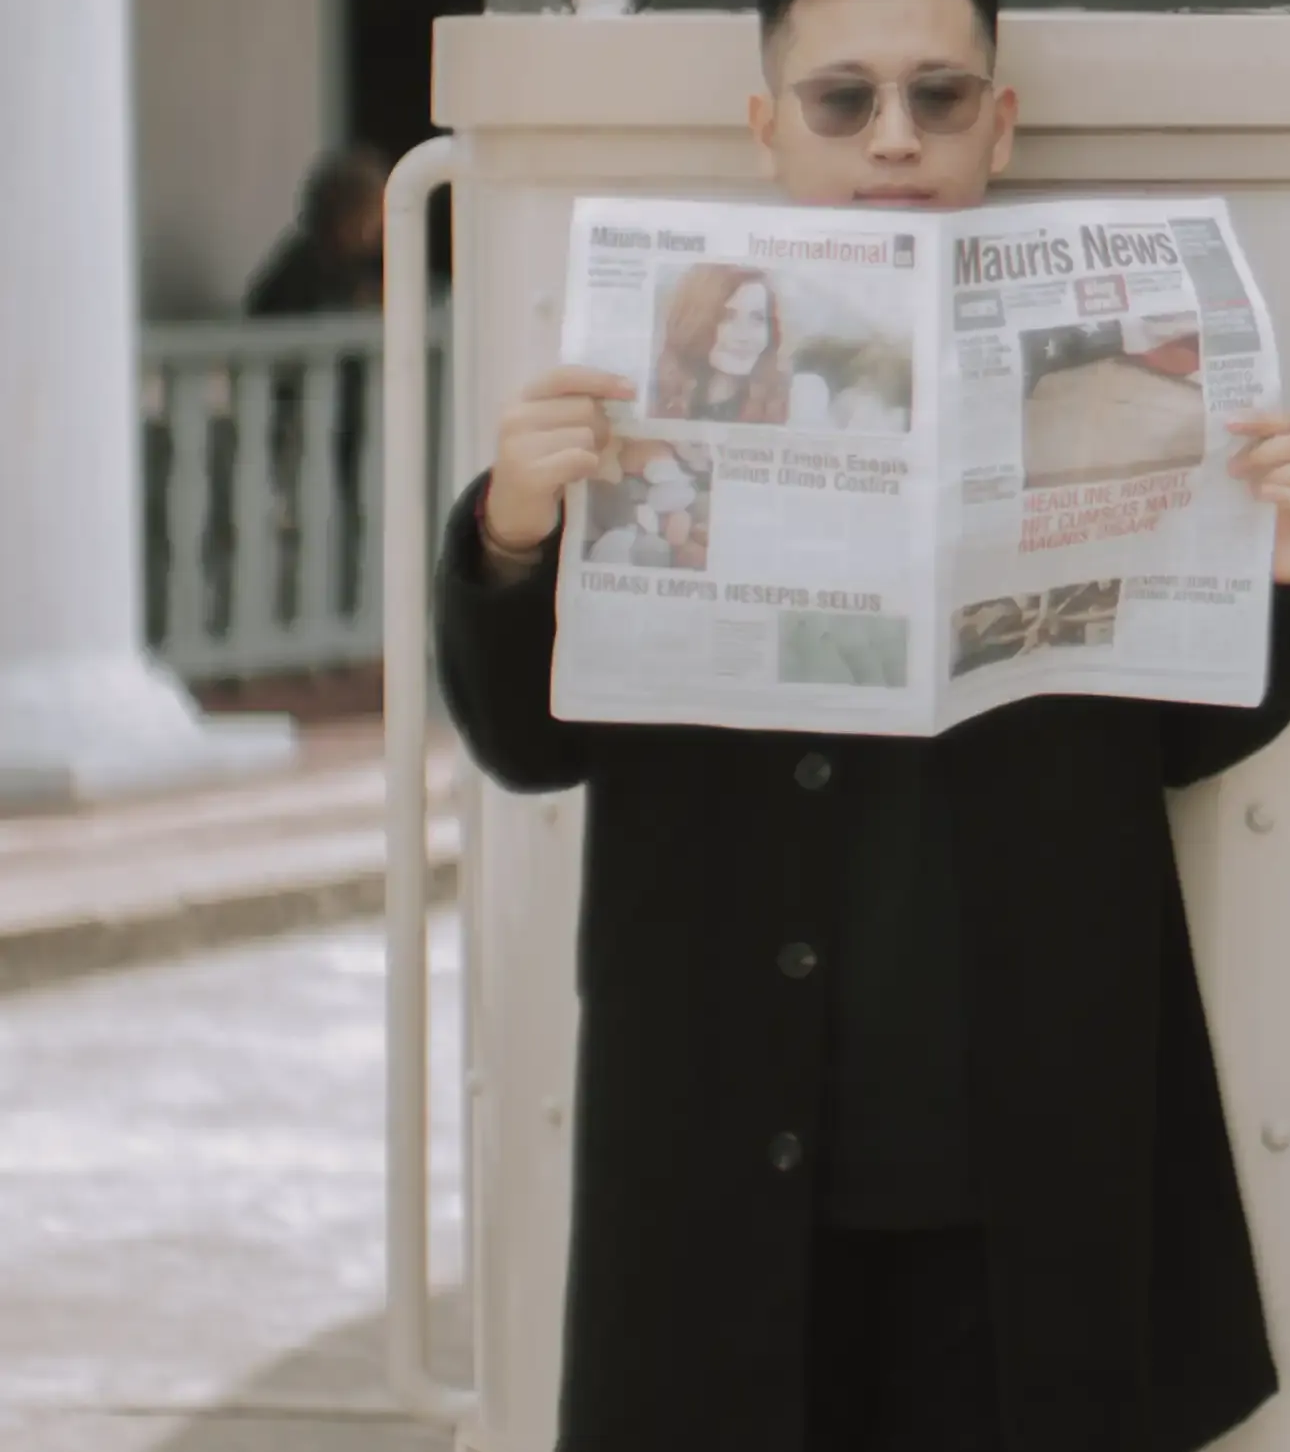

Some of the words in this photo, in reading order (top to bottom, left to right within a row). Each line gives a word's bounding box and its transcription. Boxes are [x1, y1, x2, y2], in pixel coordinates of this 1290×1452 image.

[749, 232, 888, 264] International
[953, 228, 1074, 286] Mauris
[1079, 223, 1179, 271] News
